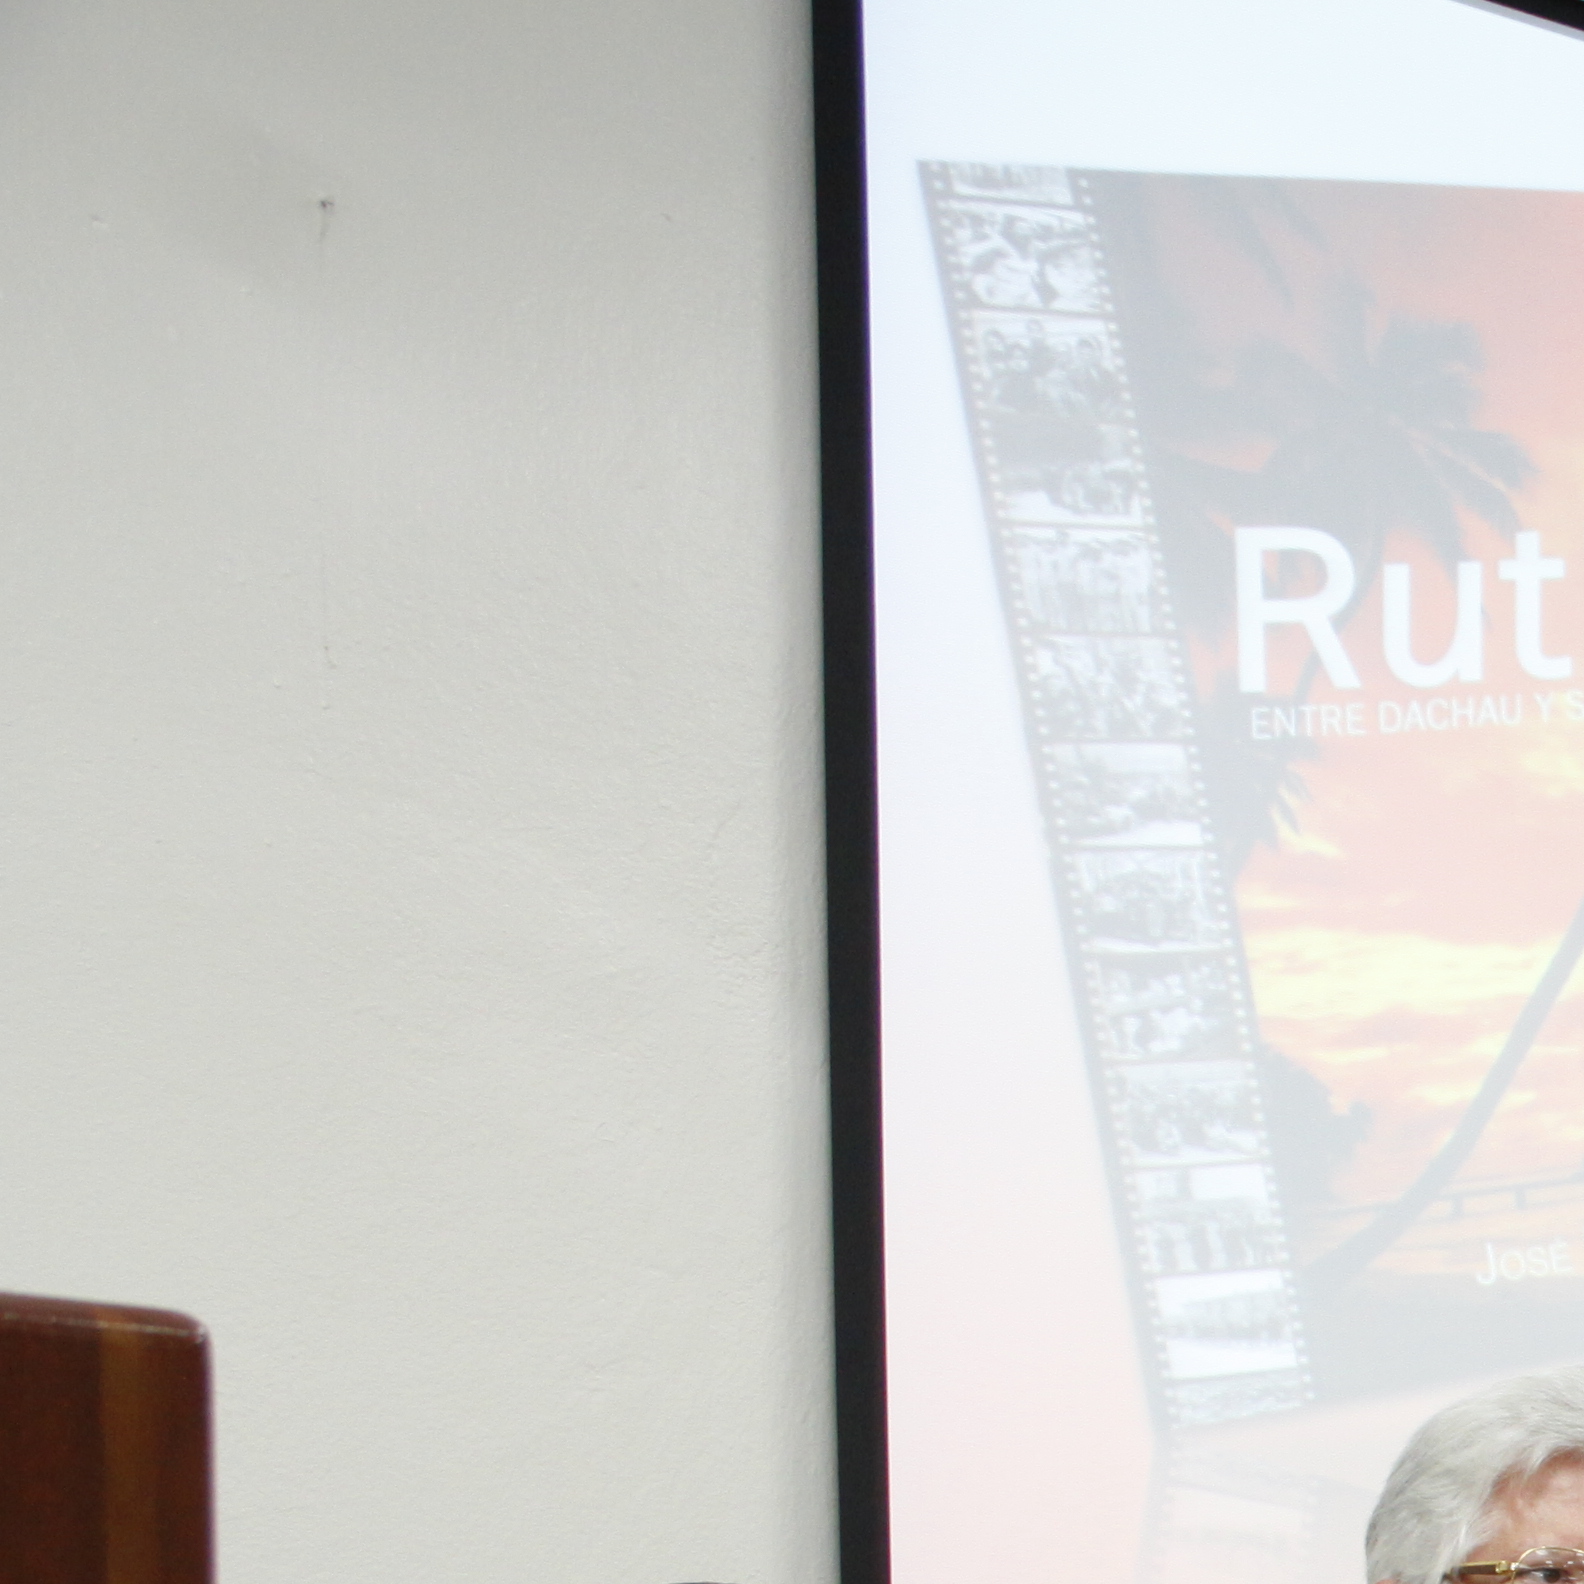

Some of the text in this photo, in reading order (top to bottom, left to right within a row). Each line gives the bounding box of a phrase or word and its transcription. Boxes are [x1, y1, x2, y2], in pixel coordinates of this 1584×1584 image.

[1251, 704, 1367, 740] ENTRE
[1378, 694, 1524, 734] DACHAU
[1534, 692, 1555, 724] Y
